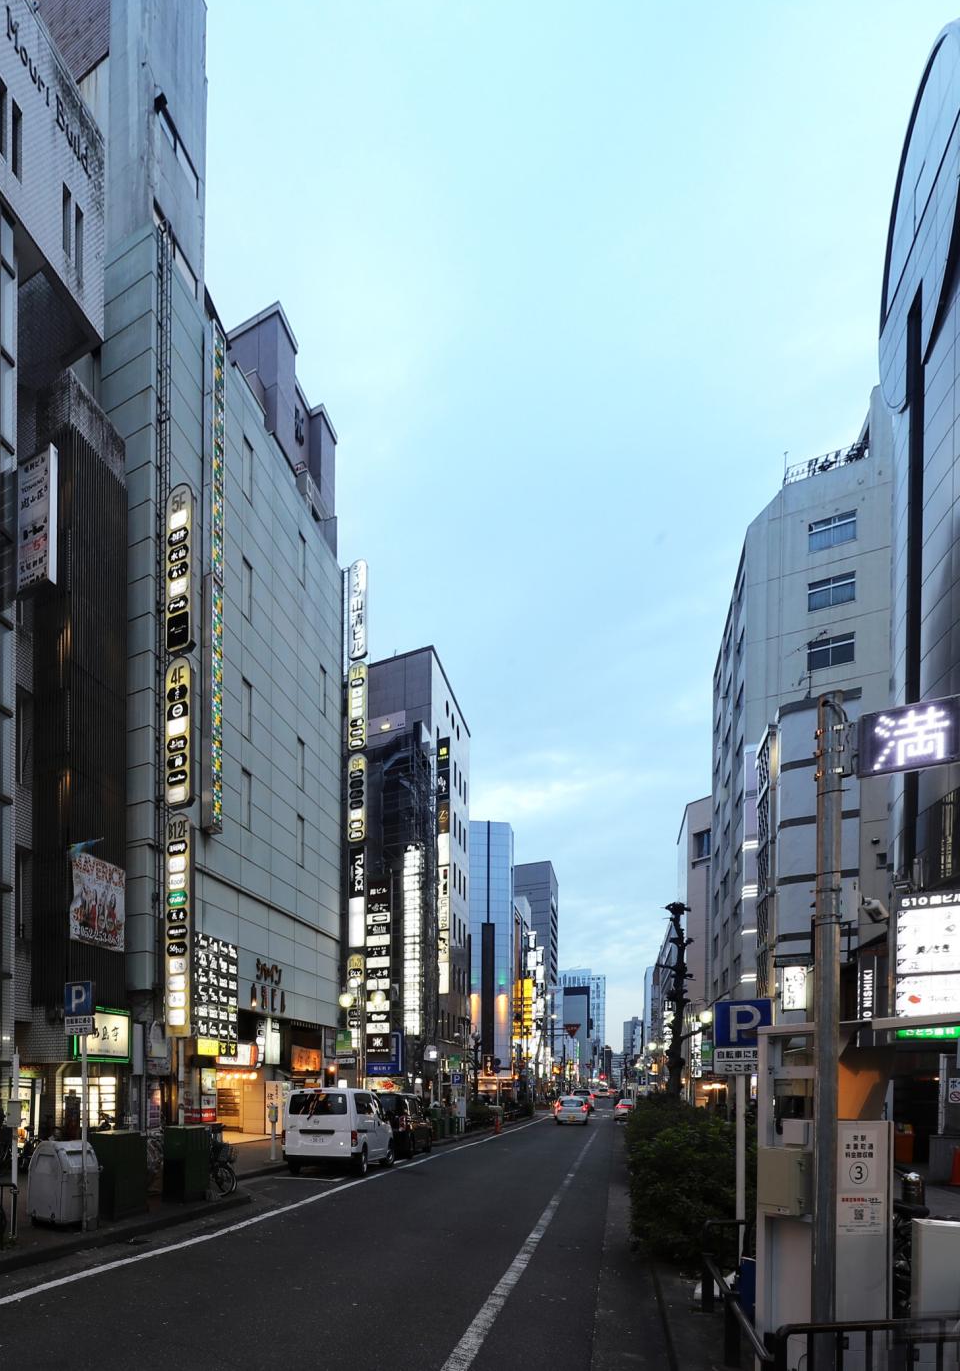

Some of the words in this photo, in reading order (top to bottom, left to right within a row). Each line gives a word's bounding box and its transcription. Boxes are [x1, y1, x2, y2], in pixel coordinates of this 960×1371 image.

[6, 5, 50, 107] Mouri
[171, 491, 186, 513] 5F
[170, 665, 185, 685] 4F
[873, 705, 951, 771] 満
[354, 853, 364, 892] TRANCE
[71, 985, 87, 1013] P
[862, 969, 873, 1007] NISHIKI
[729, 1004, 762, 1042] P
